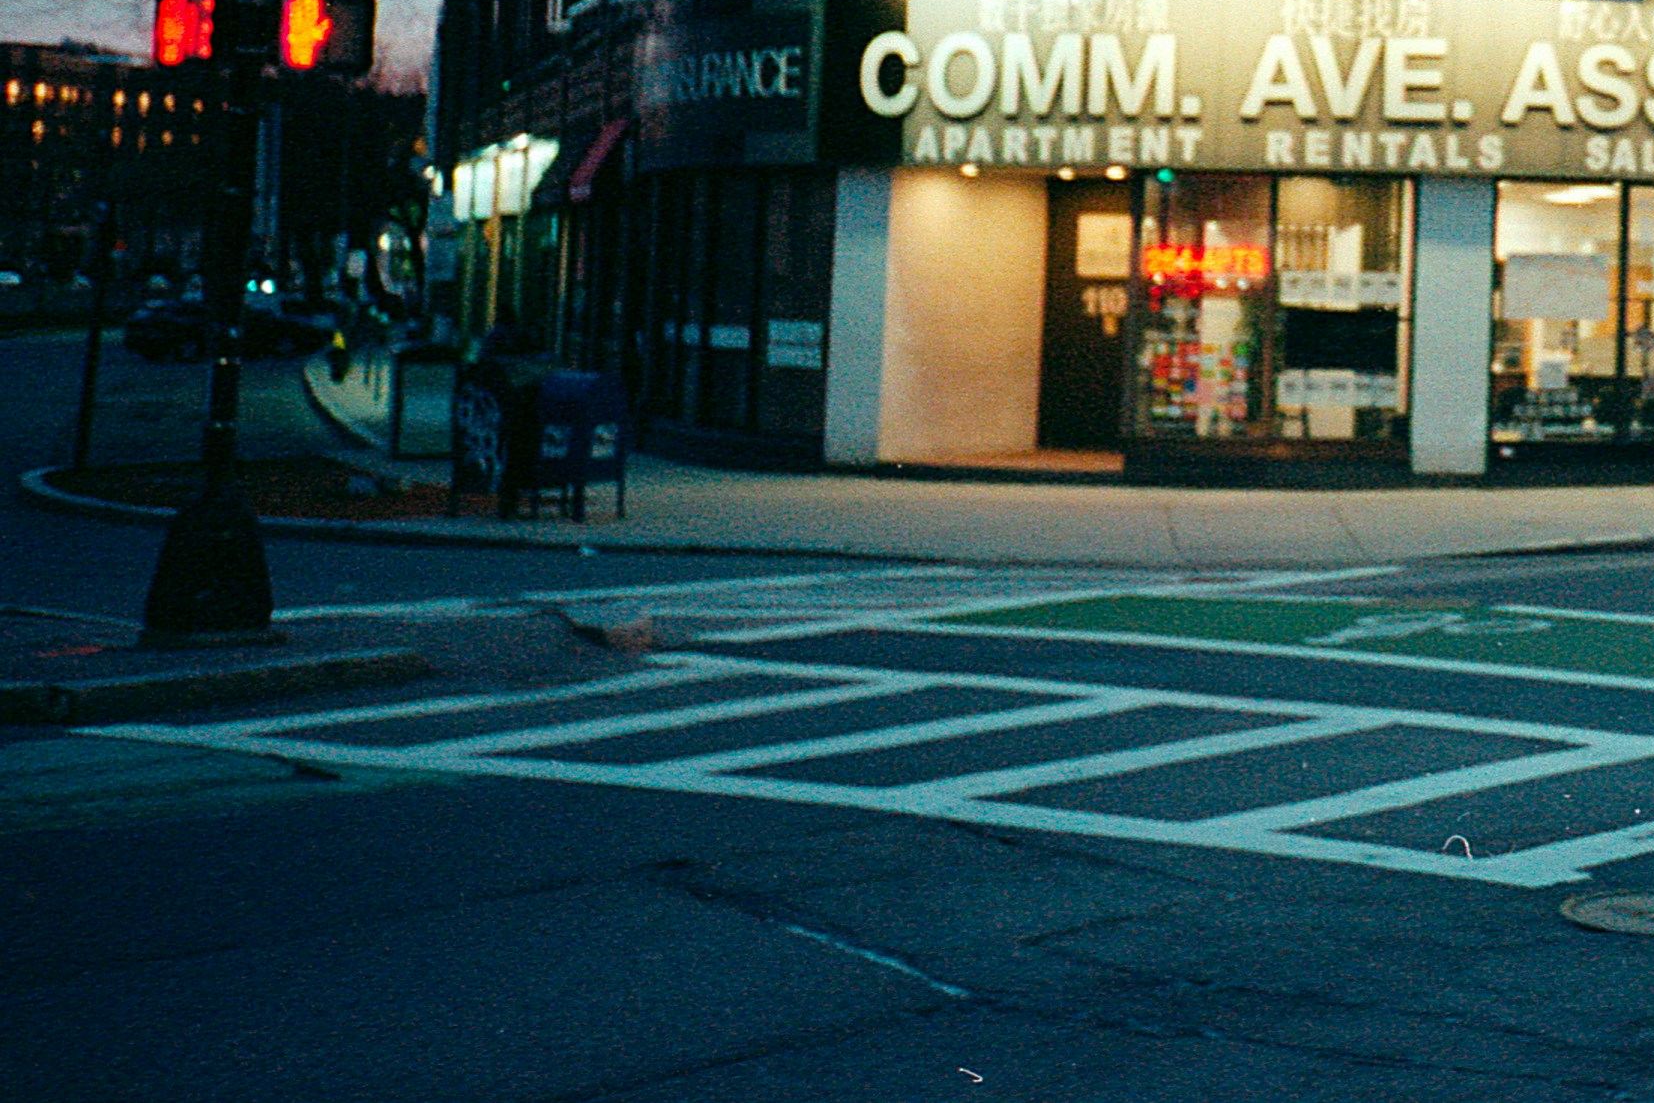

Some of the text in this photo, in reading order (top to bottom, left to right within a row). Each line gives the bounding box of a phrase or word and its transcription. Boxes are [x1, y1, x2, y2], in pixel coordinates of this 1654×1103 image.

[859, 30, 1201, 120] COMM.
[1240, 35, 1474, 124] AVE.
[914, 126, 1203, 164] APARTMENT
[1264, 129, 1505, 171] RENTALS
